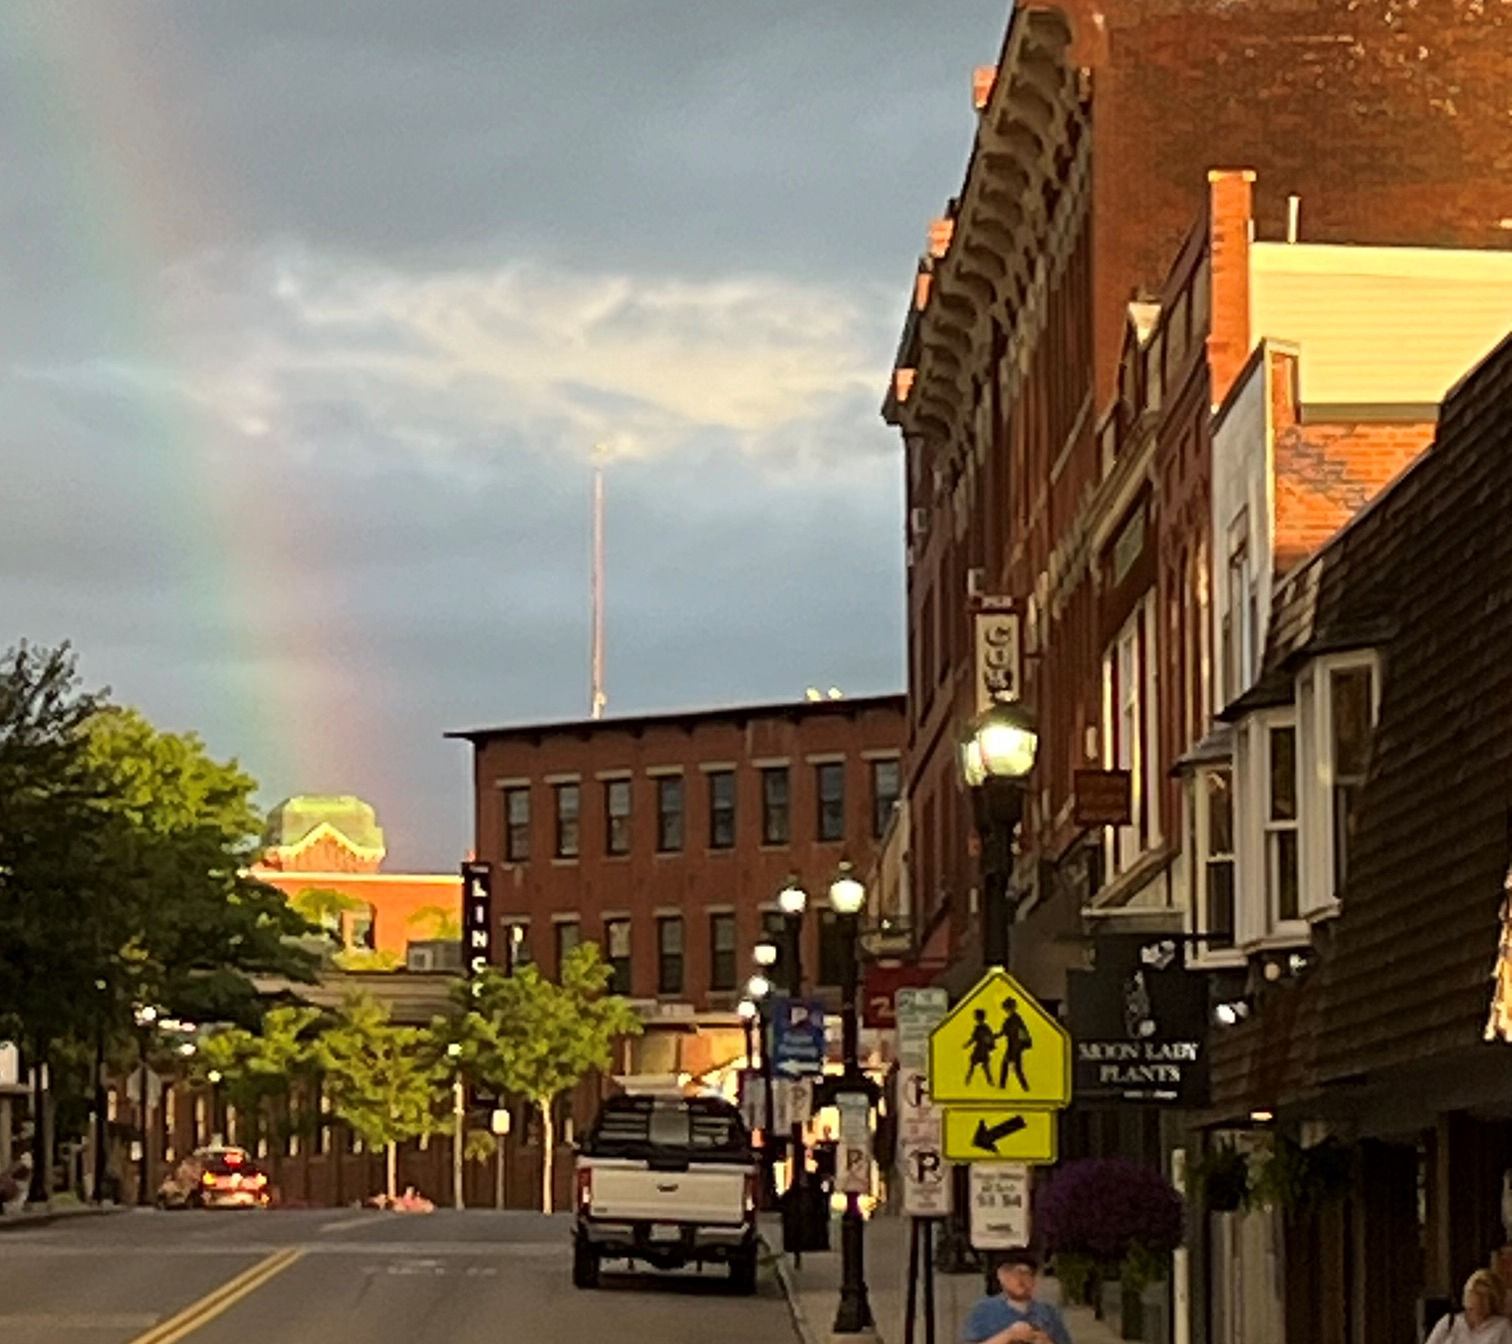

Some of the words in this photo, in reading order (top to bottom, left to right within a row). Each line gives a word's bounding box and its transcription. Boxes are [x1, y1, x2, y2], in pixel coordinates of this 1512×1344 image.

[1078, 1042, 1139, 1061] MOON
[1144, 1041, 1200, 1061] LADY
[1099, 1064, 1181, 1082] PLANTS
